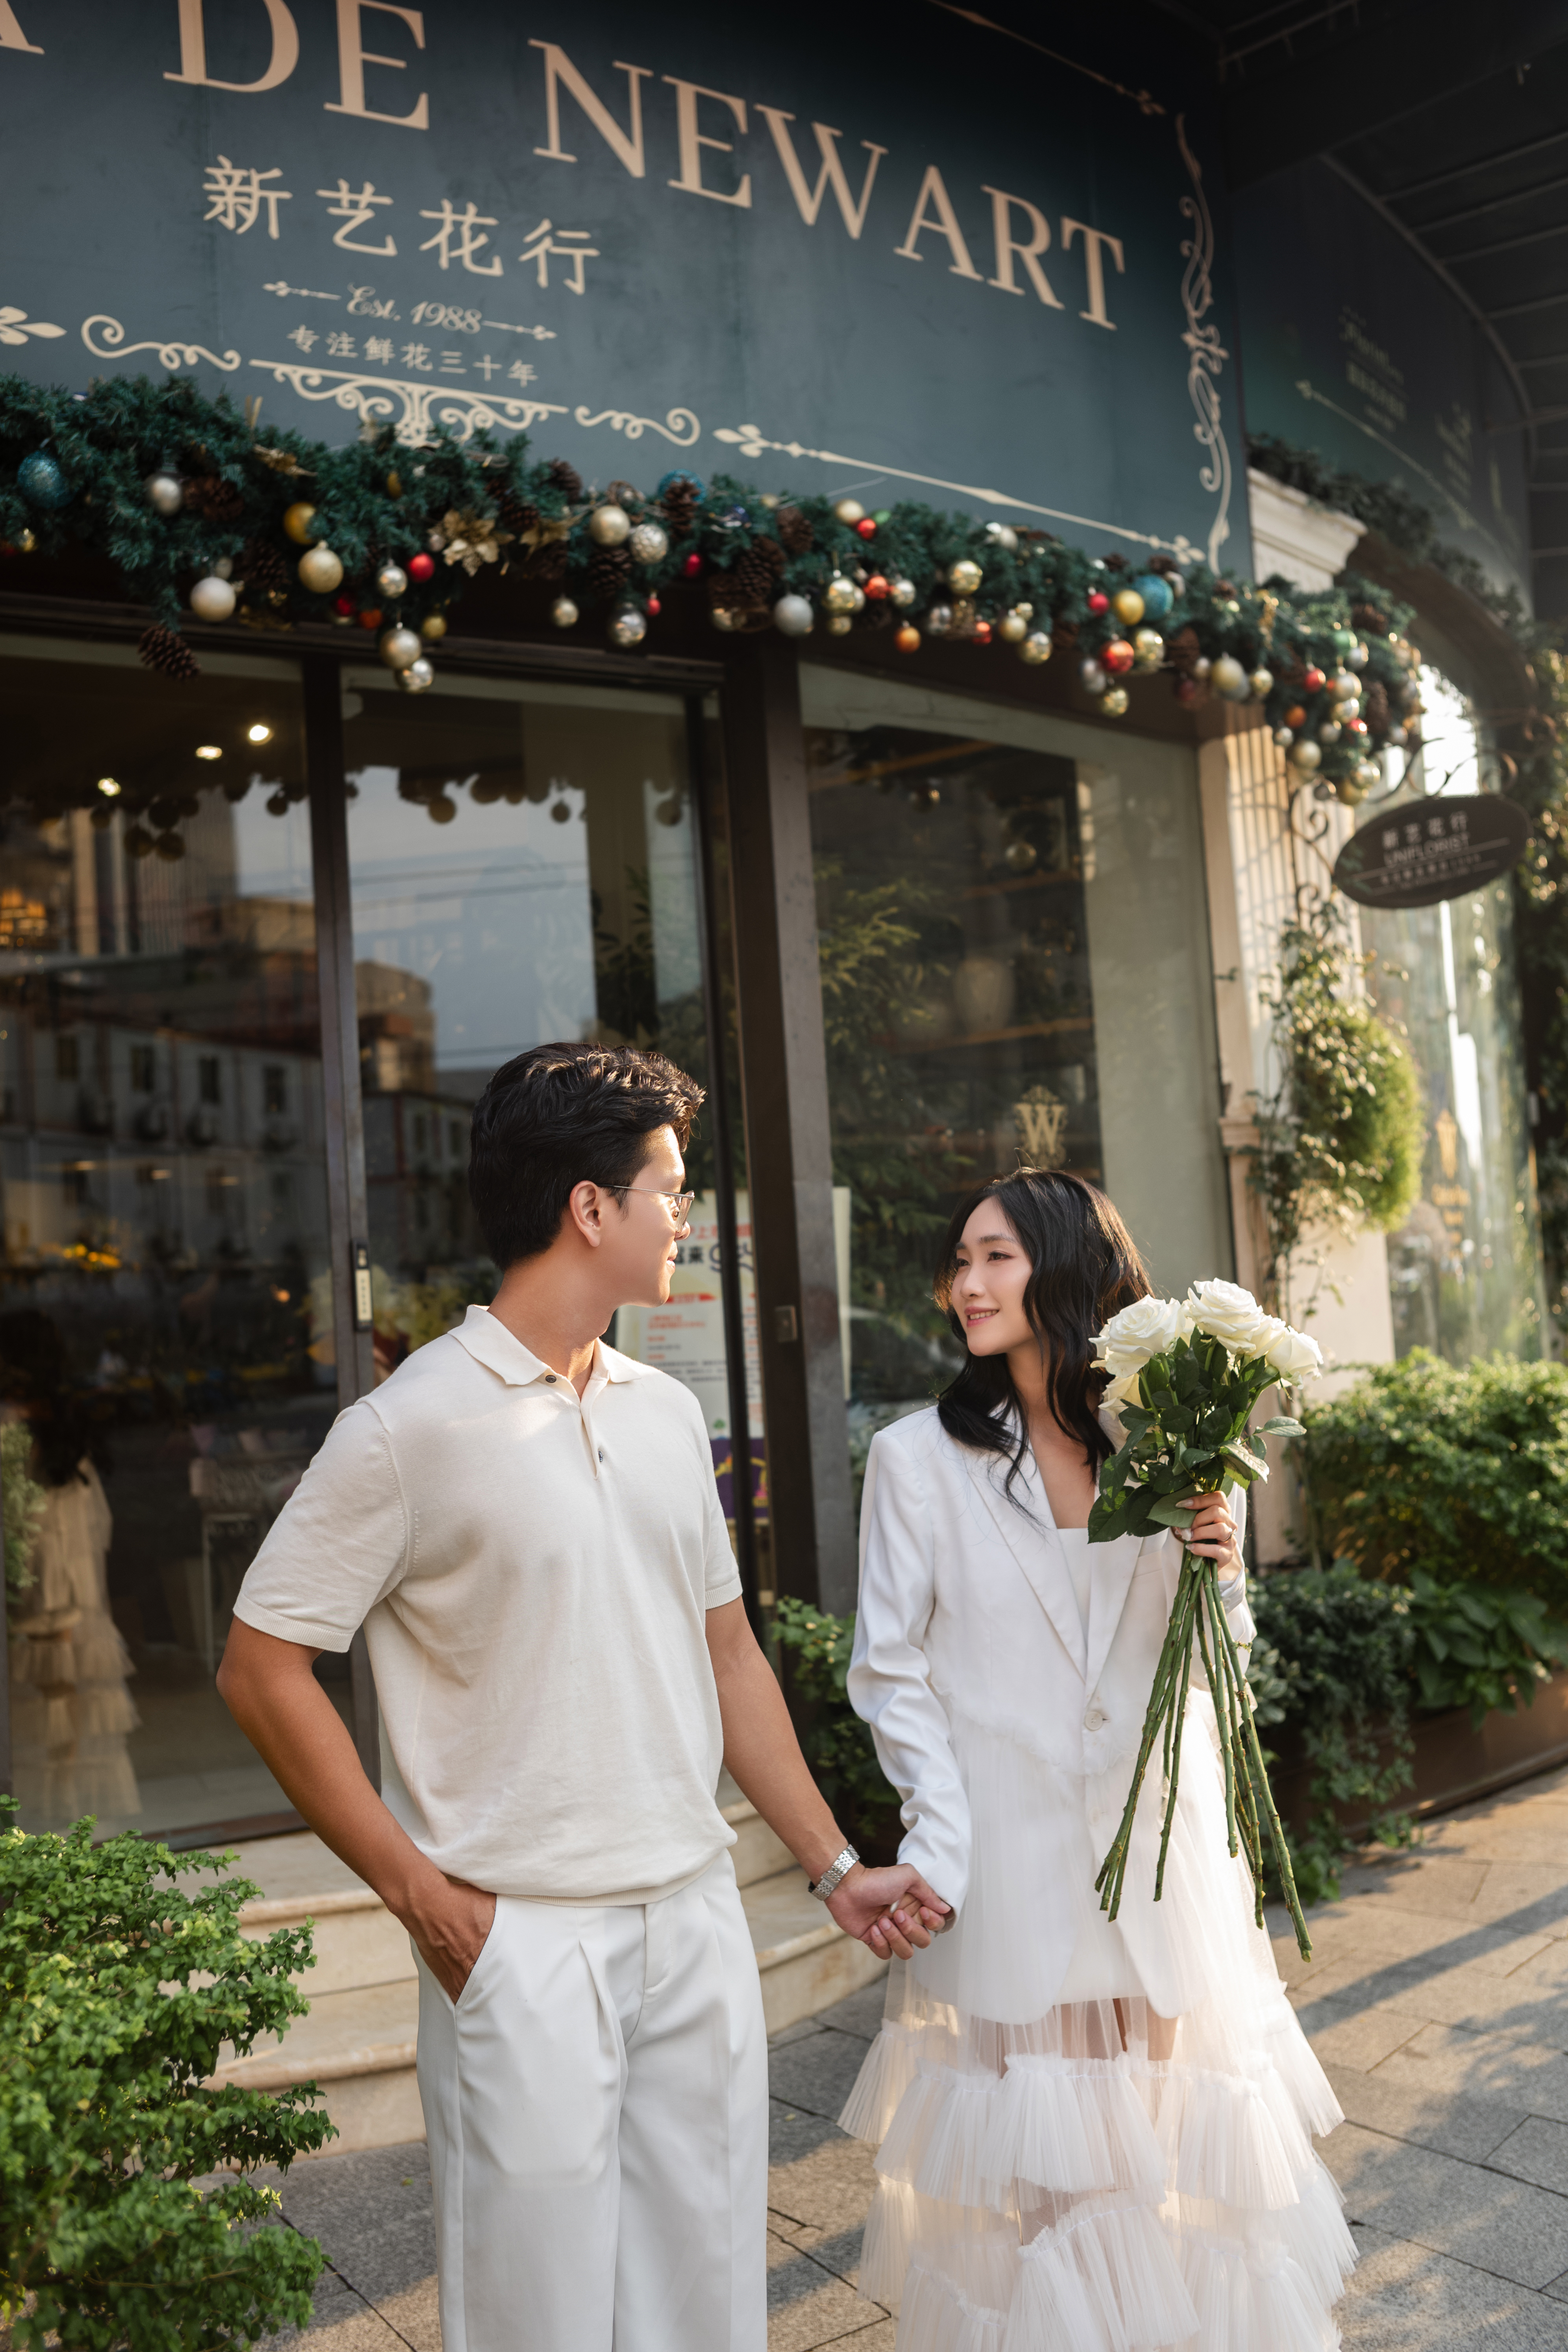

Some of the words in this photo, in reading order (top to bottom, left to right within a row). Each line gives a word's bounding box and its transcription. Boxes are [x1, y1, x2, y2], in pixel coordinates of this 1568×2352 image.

[163, 0, 429, 130] DE
[528, 39, 1126, 330] NEWART
[203, 155, 601, 295] 新艺花行
[346, 282, 401, 322] Est.
[410, 301, 482, 335] 1988
[287, 324, 539, 388] 专注鲜花三十年
[1013, 1103, 1066, 1155] W
